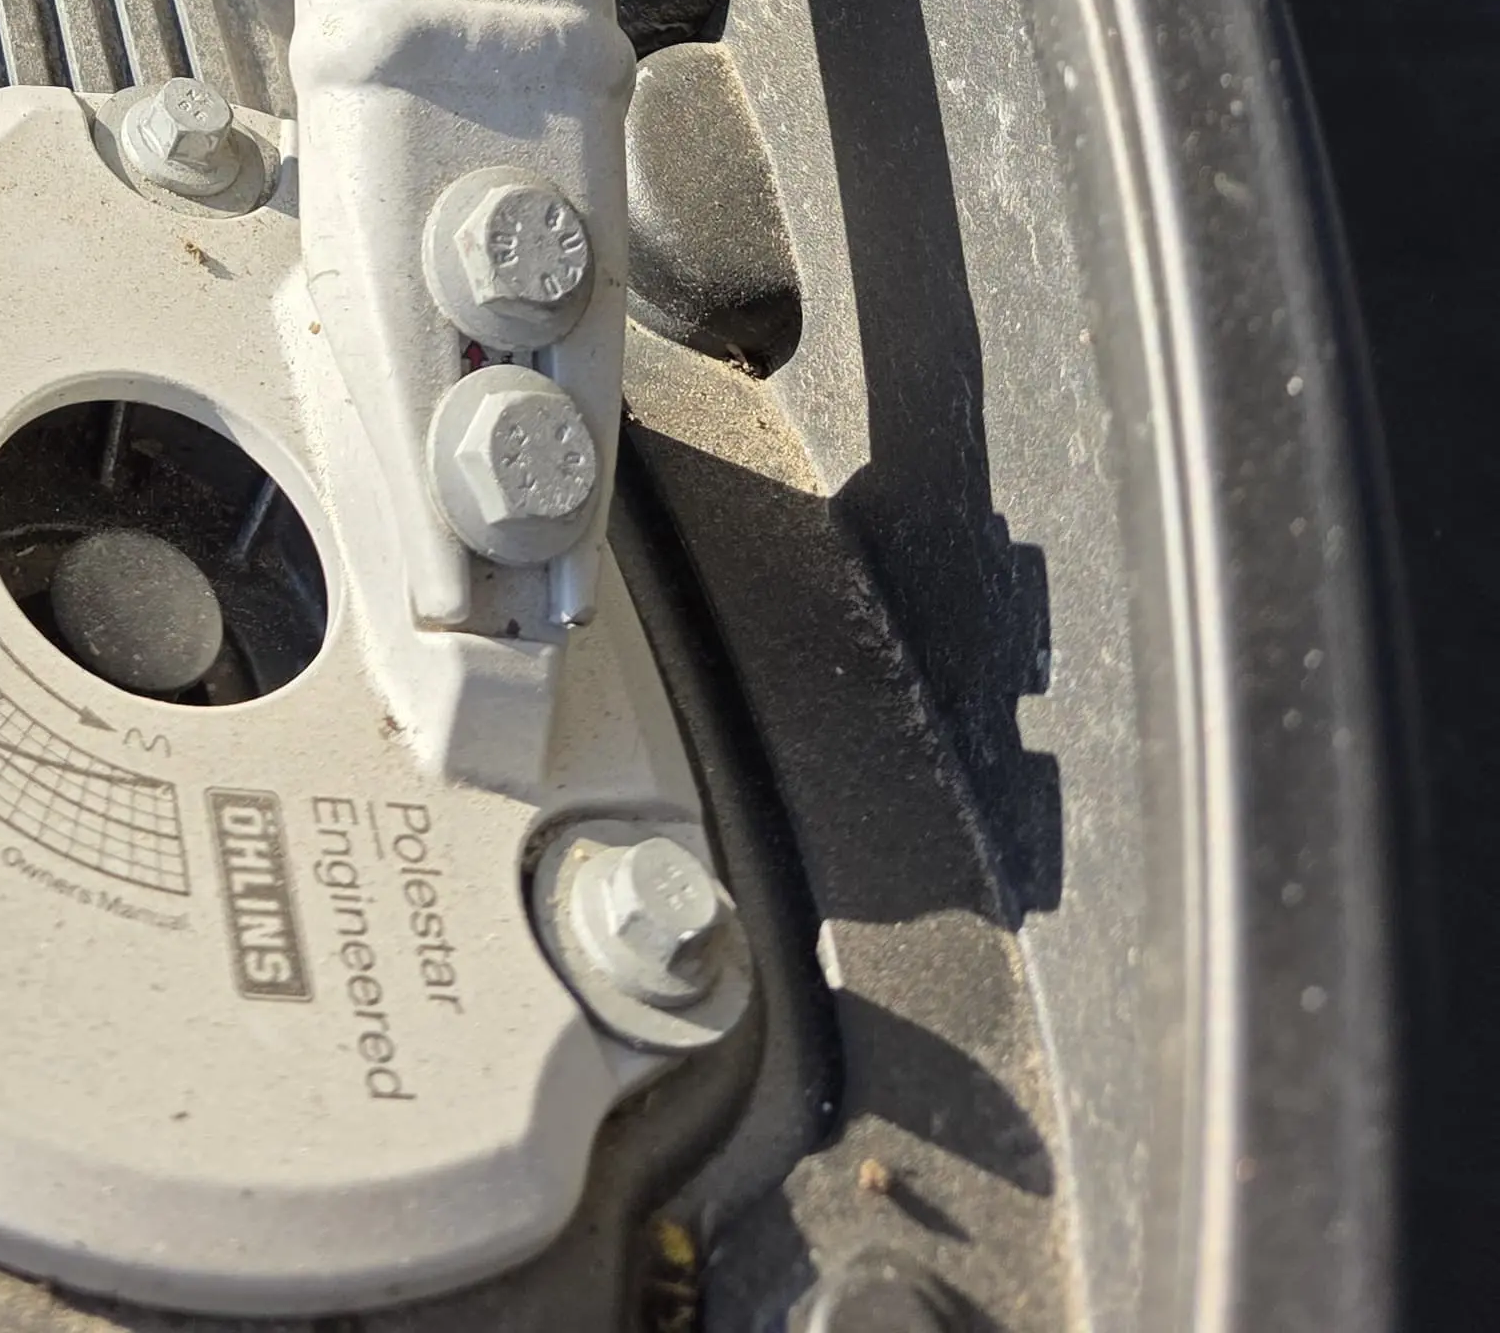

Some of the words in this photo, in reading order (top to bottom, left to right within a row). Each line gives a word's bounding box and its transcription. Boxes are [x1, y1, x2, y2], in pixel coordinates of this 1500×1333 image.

[220, 804, 293, 983] ÖHLINS
[311, 796, 418, 1101] Engineered
[386, 801, 466, 1015] Polestar
